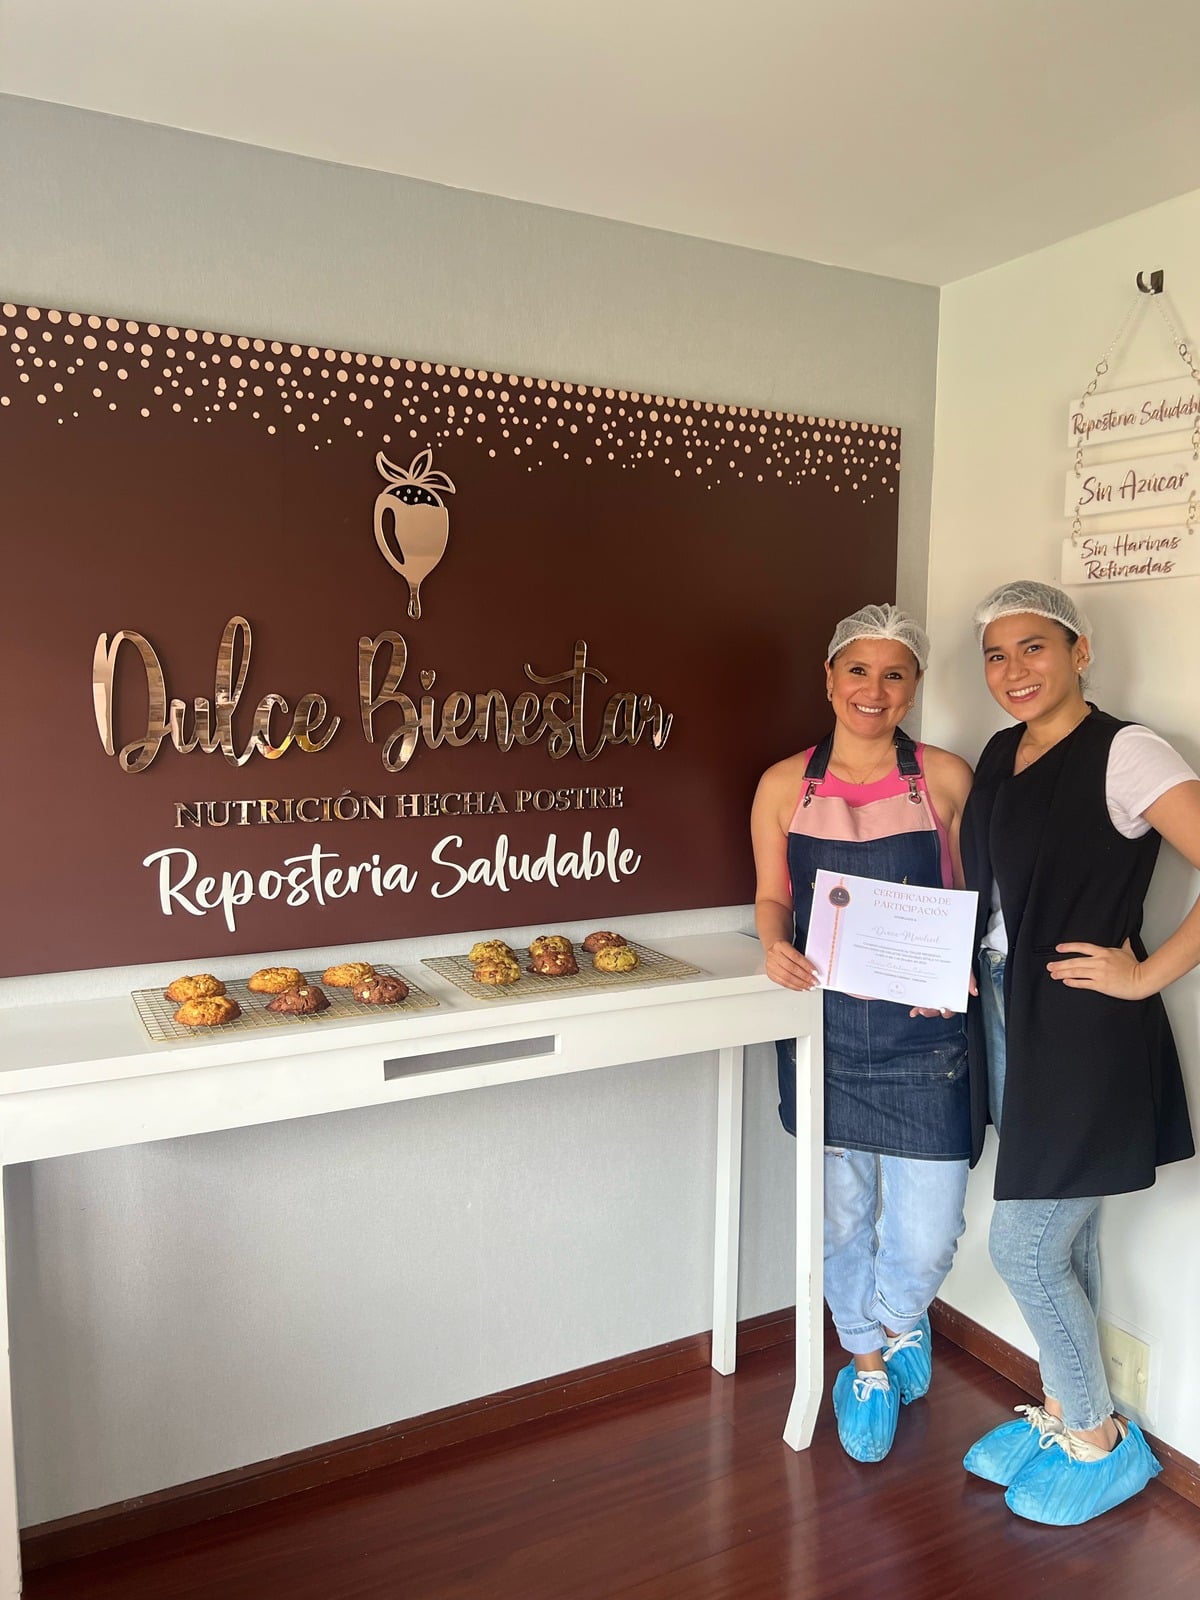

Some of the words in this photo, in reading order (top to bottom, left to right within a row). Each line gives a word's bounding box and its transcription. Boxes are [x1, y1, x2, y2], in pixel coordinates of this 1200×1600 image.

[1079, 476, 1112, 505] Sin
[1081, 538, 1107, 559] Sin
[1113, 534, 1181, 557] Harinas
[1085, 557, 1176, 579] Refinadas
[93, 615, 341, 774] Dulce
[357, 630, 674, 773] Bienestar
[174, 789, 386, 828] NUTRICIÓN
[395, 791, 508, 818] HECHA
[514, 786, 624, 813] POSTRE
[142, 843, 418, 932] Reposteria
[430, 827, 642, 899] Saludable
[873, 888, 936, 904] CERTIFICADO
[938, 897, 952, 906] DE
[873, 900, 949, 917] PARTICIPACIÓN
